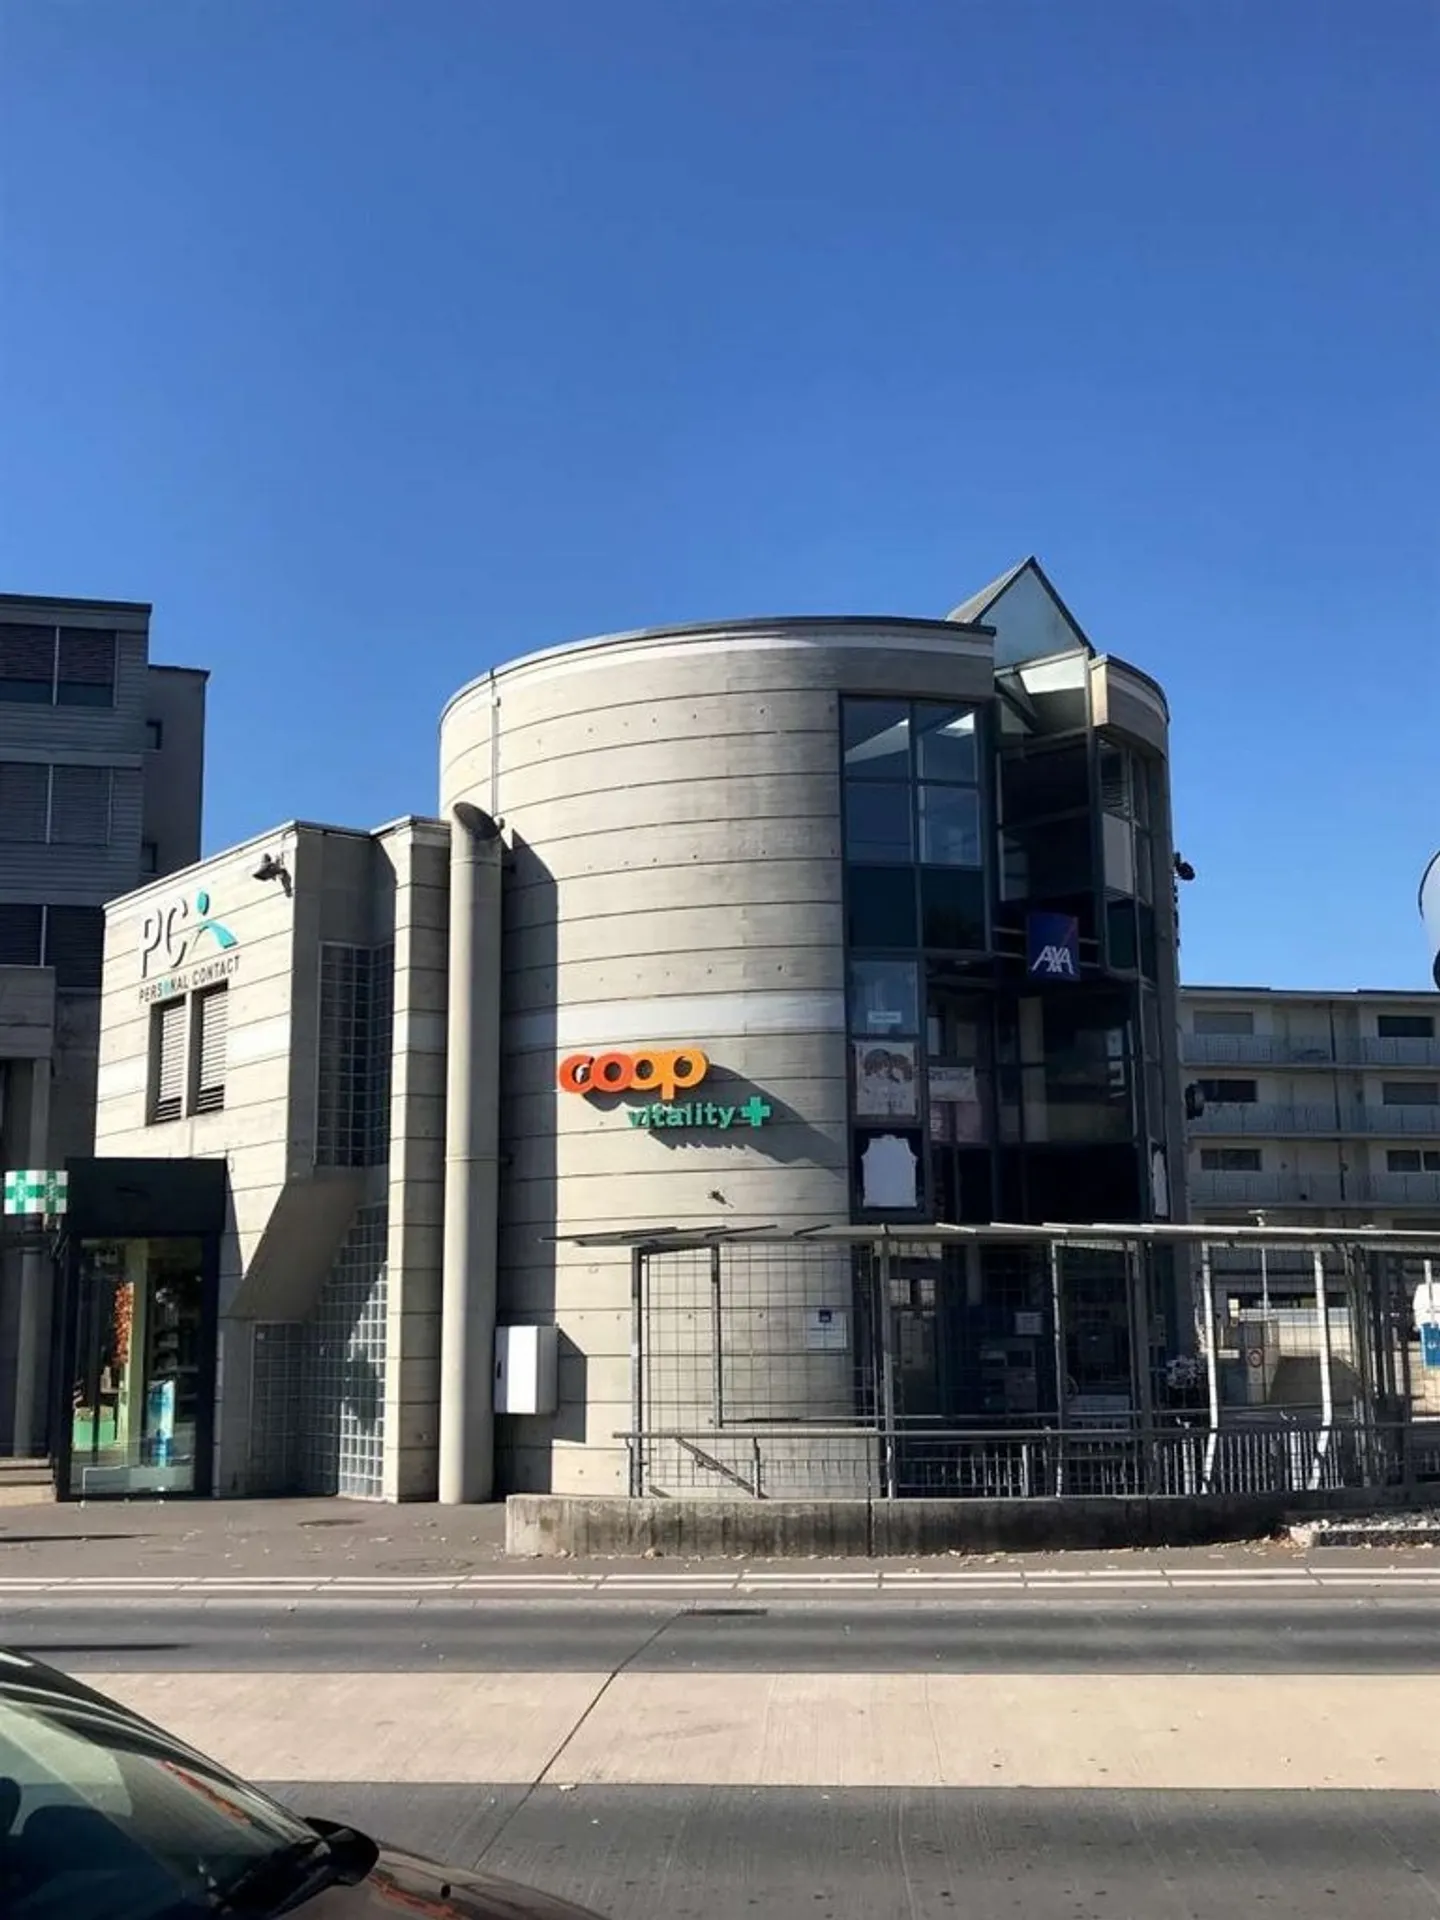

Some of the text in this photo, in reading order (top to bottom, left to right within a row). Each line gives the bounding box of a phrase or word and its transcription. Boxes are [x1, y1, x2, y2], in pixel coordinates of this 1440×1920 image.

[140, 895, 189, 979] PC
[192, 954, 241, 986] CONTACT
[1031, 944, 1075, 975] AXA
[559, 1049, 709, 1102] coop
[627, 1101, 737, 1129] vitality
